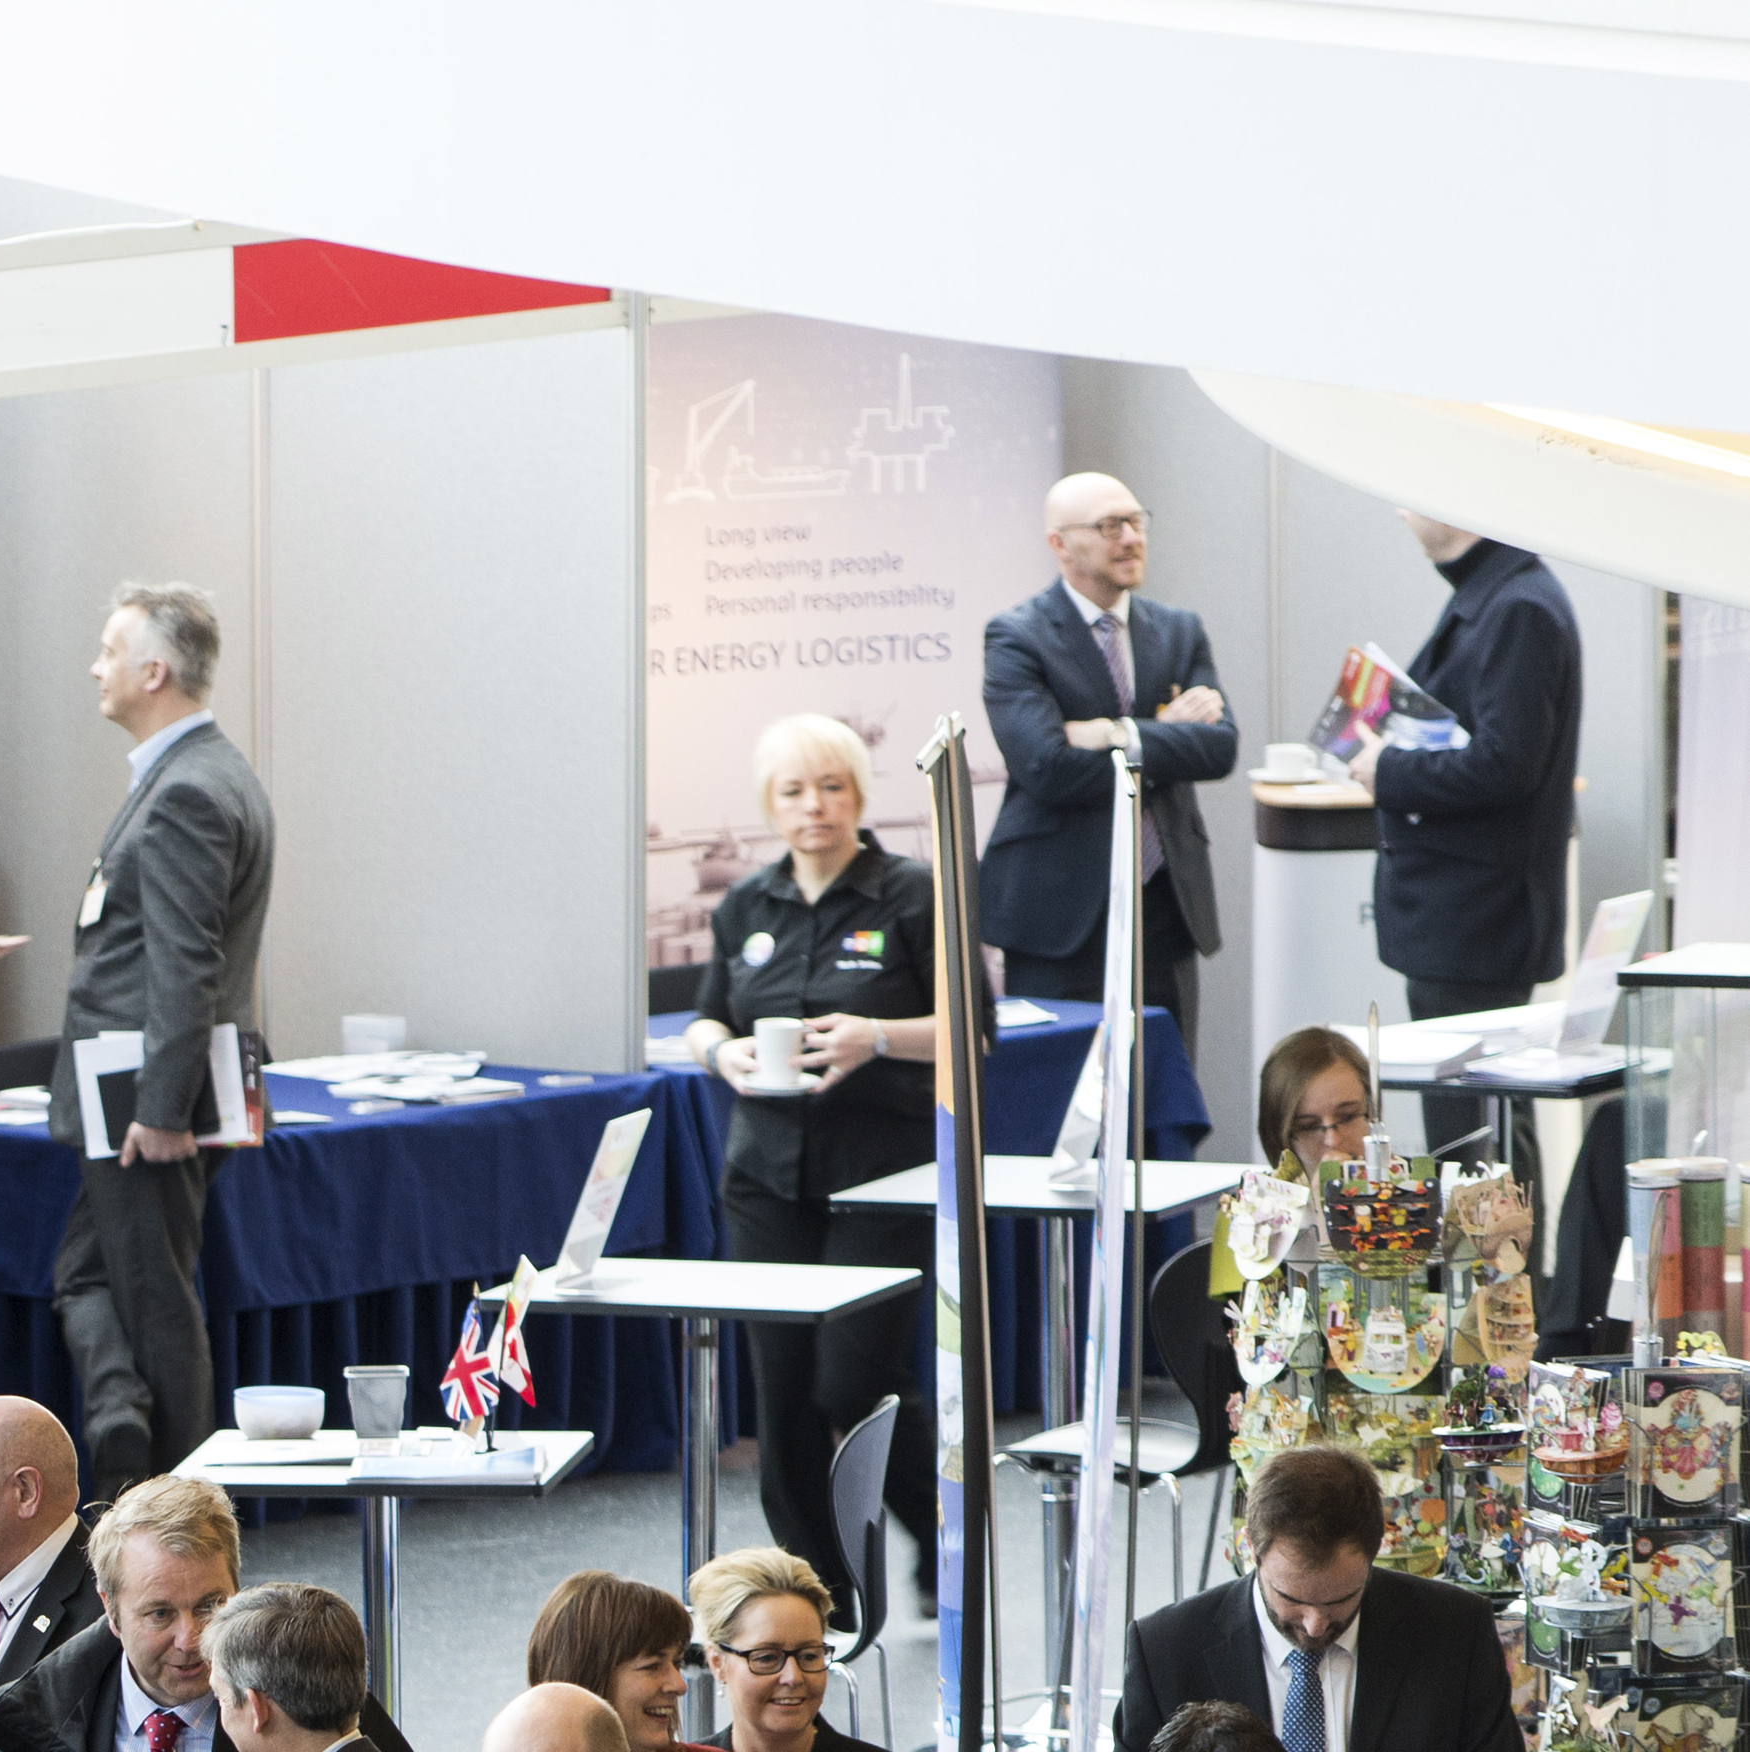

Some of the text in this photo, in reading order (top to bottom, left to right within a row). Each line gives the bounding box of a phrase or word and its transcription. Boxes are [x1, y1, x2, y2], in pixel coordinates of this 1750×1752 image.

[705, 523, 811, 549] Long view
[705, 551, 904, 582] Developing people
[705, 583, 956, 617] Personal responsibility
[674, 639, 787, 676] ENERGY
[795, 632, 954, 668] LOGISTICS
